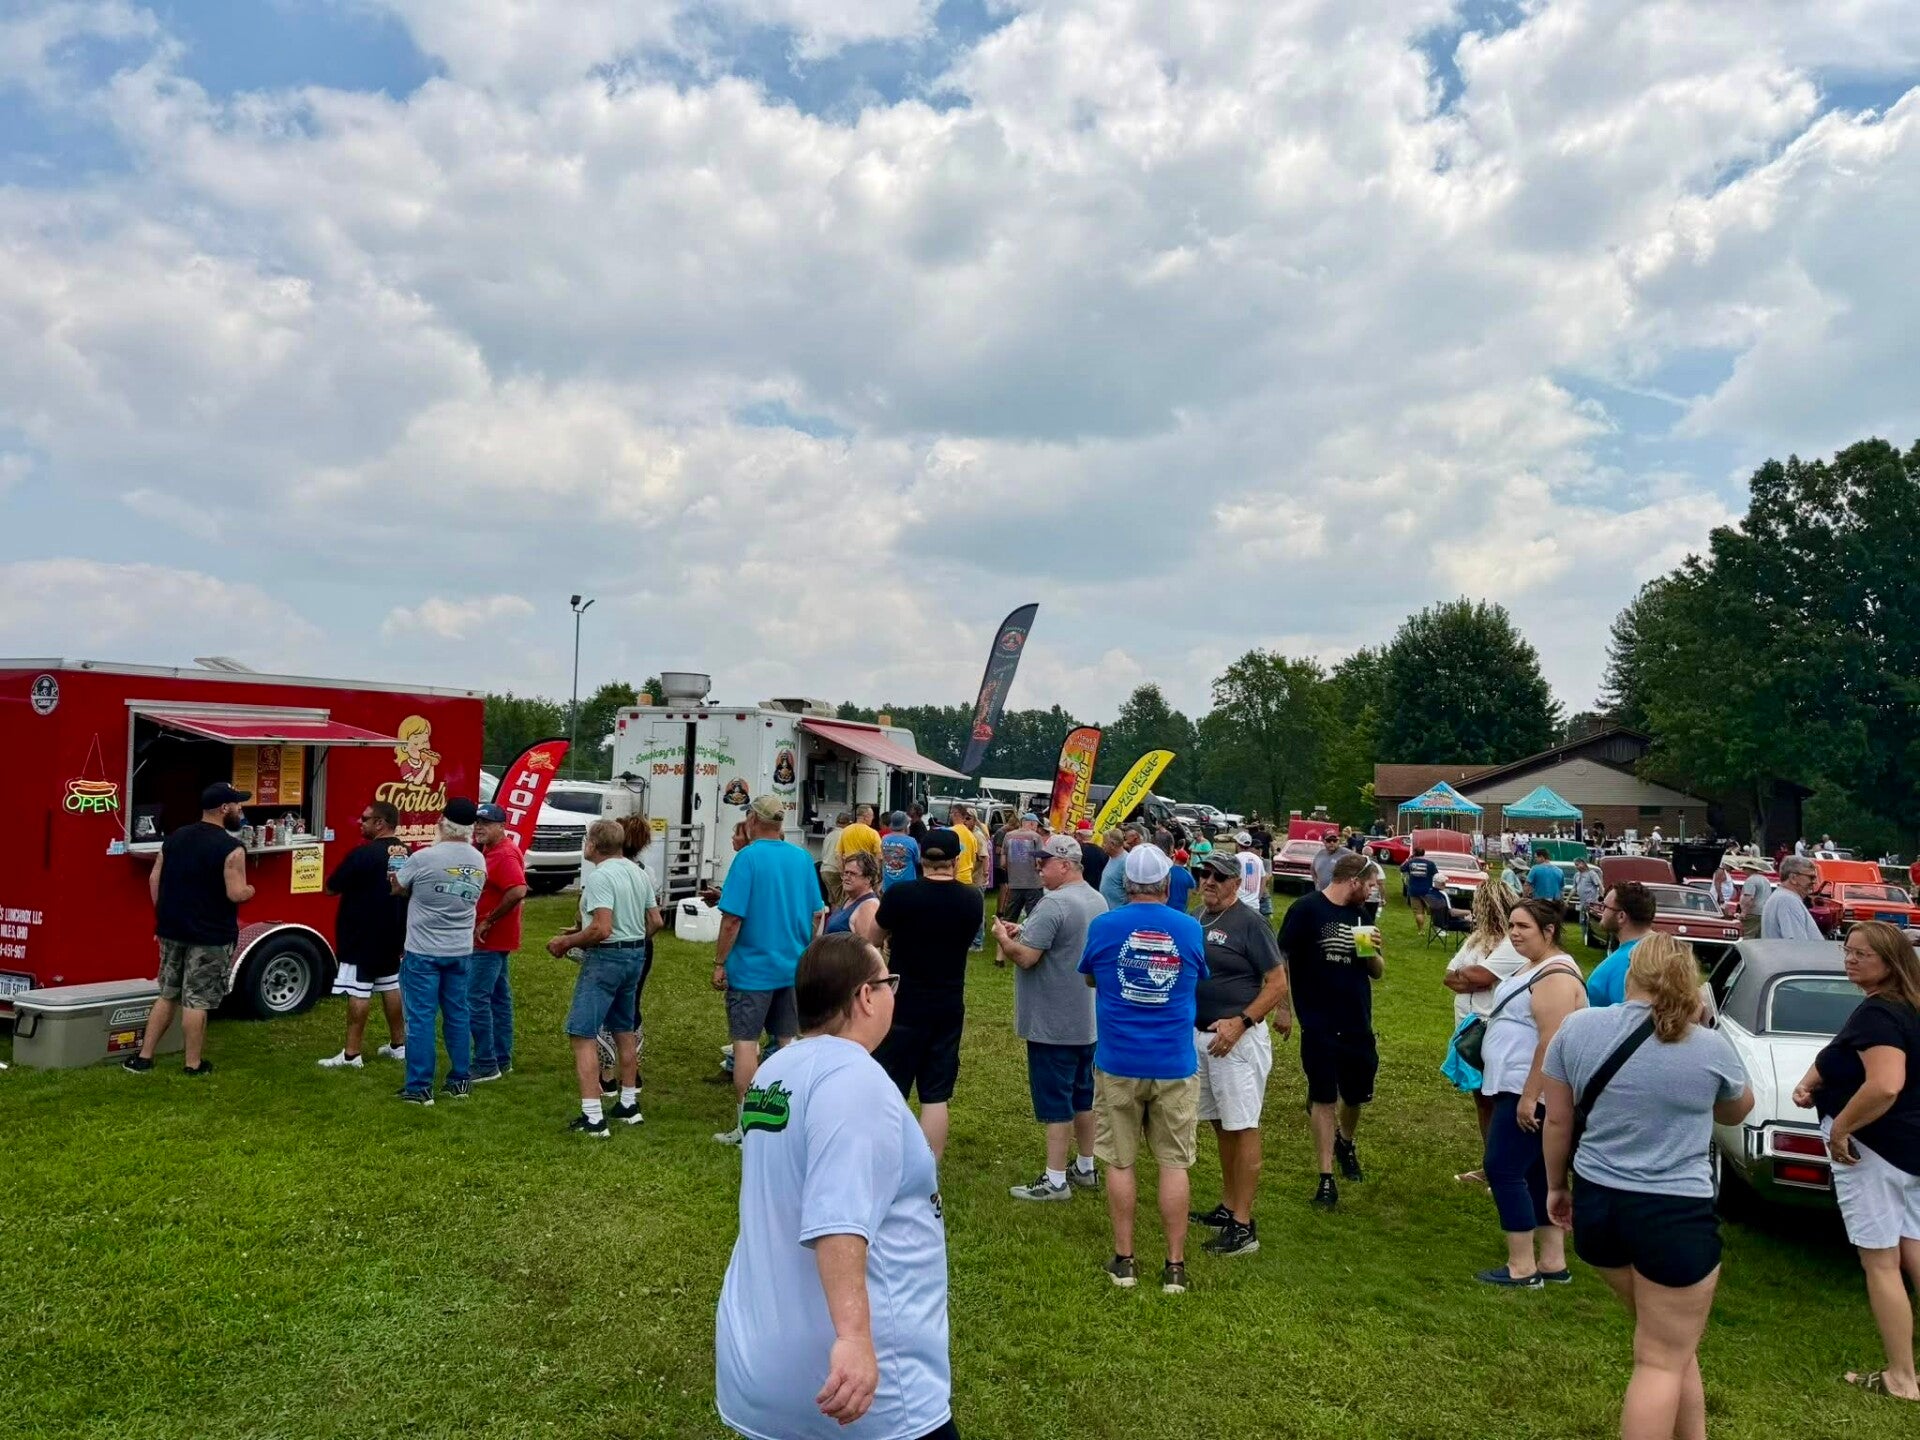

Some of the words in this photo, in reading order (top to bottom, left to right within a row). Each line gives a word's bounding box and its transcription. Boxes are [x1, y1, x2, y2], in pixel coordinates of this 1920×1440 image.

[66, 795, 118, 812] OPEN
[375, 781, 447, 812] Tootie's
[506, 770, 540, 826] HOT
[33, 911, 42, 924] LLC
